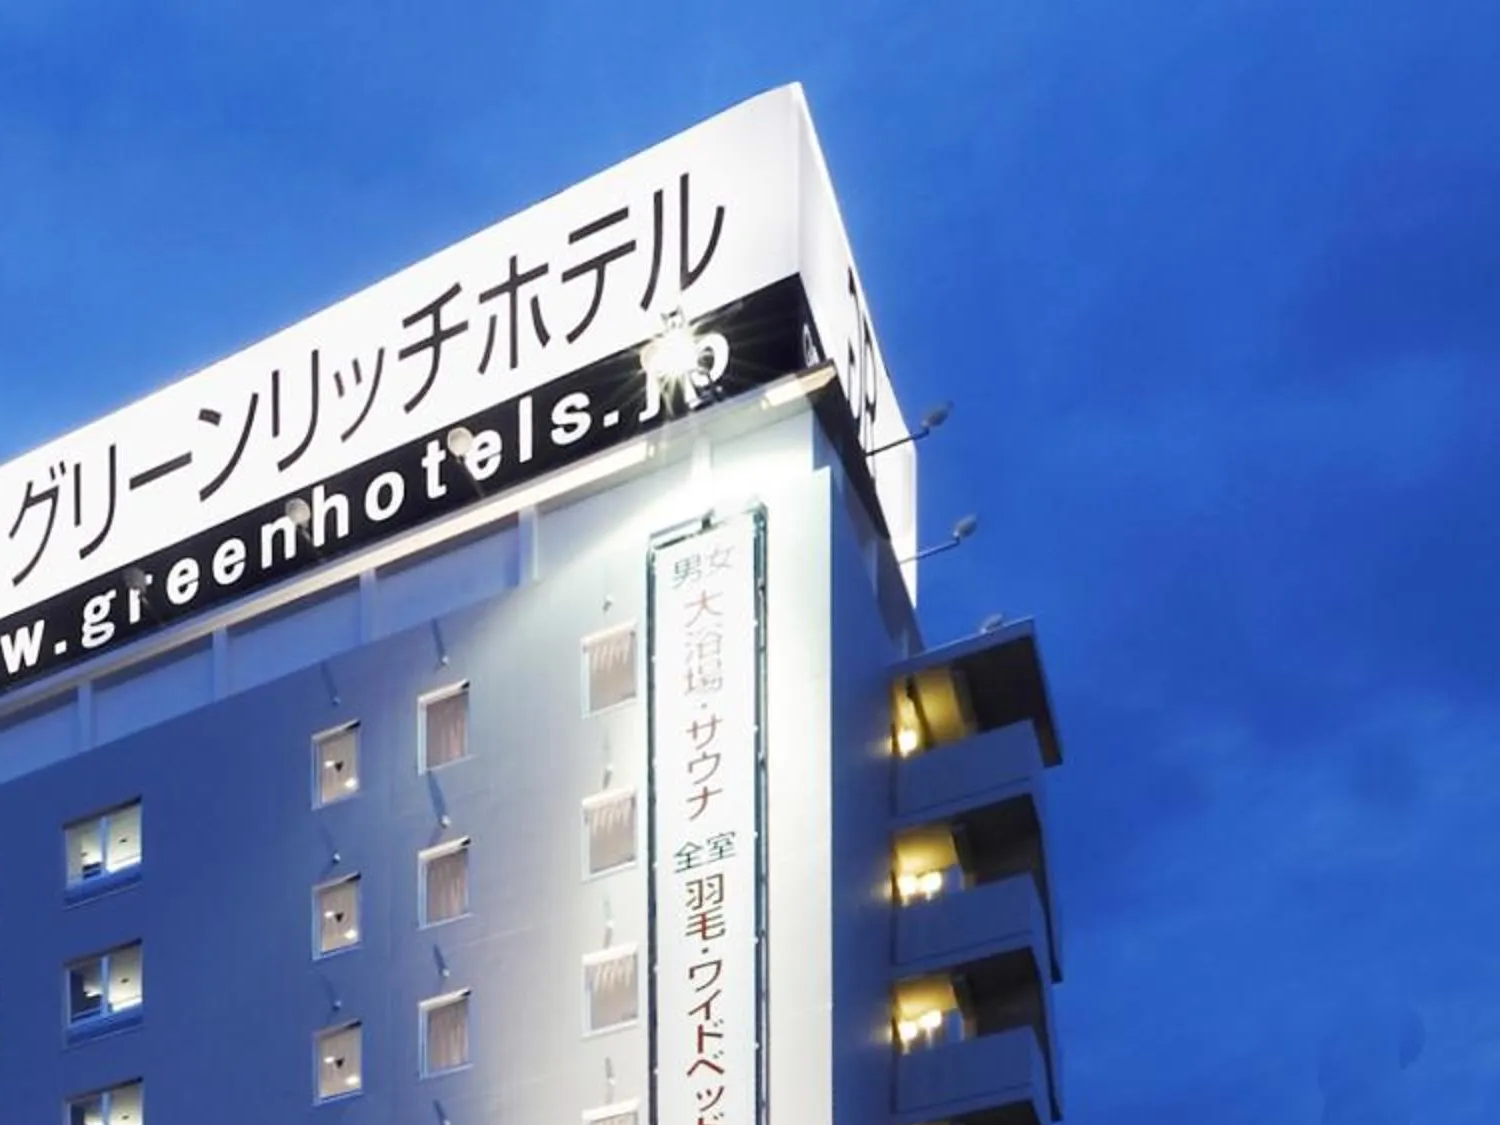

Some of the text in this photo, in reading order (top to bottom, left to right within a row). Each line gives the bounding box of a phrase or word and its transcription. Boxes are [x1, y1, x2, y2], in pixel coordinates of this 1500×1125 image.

[9, 172, 725, 588] グリーンリッチホテル
